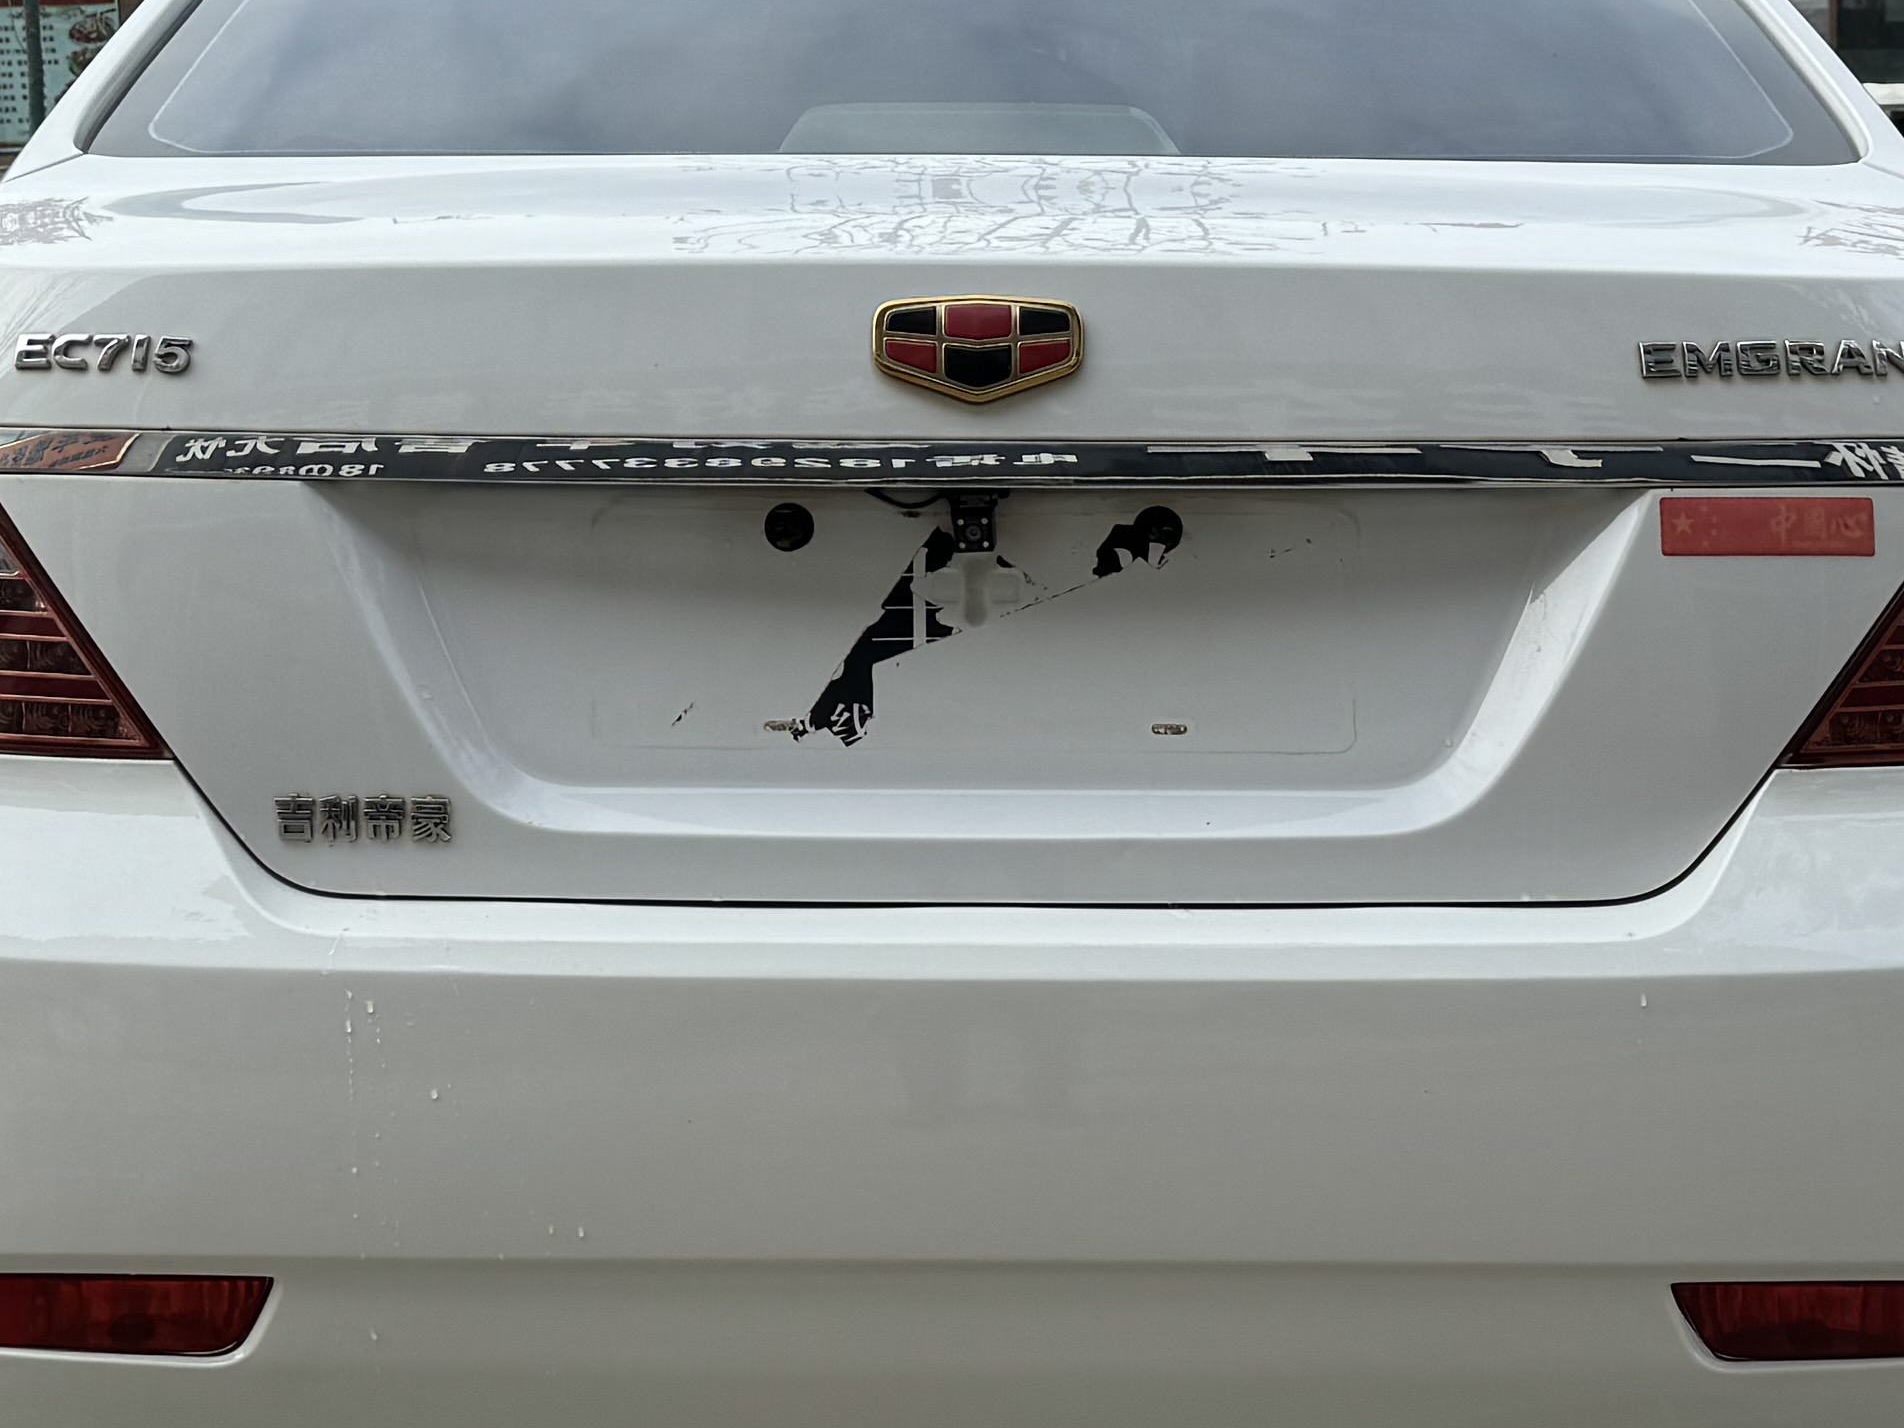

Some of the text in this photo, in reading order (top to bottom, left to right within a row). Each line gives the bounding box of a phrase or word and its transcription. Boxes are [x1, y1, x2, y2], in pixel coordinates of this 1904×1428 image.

[14, 332, 194, 374] EC715
[273, 793, 453, 845] 吉利帝豪
